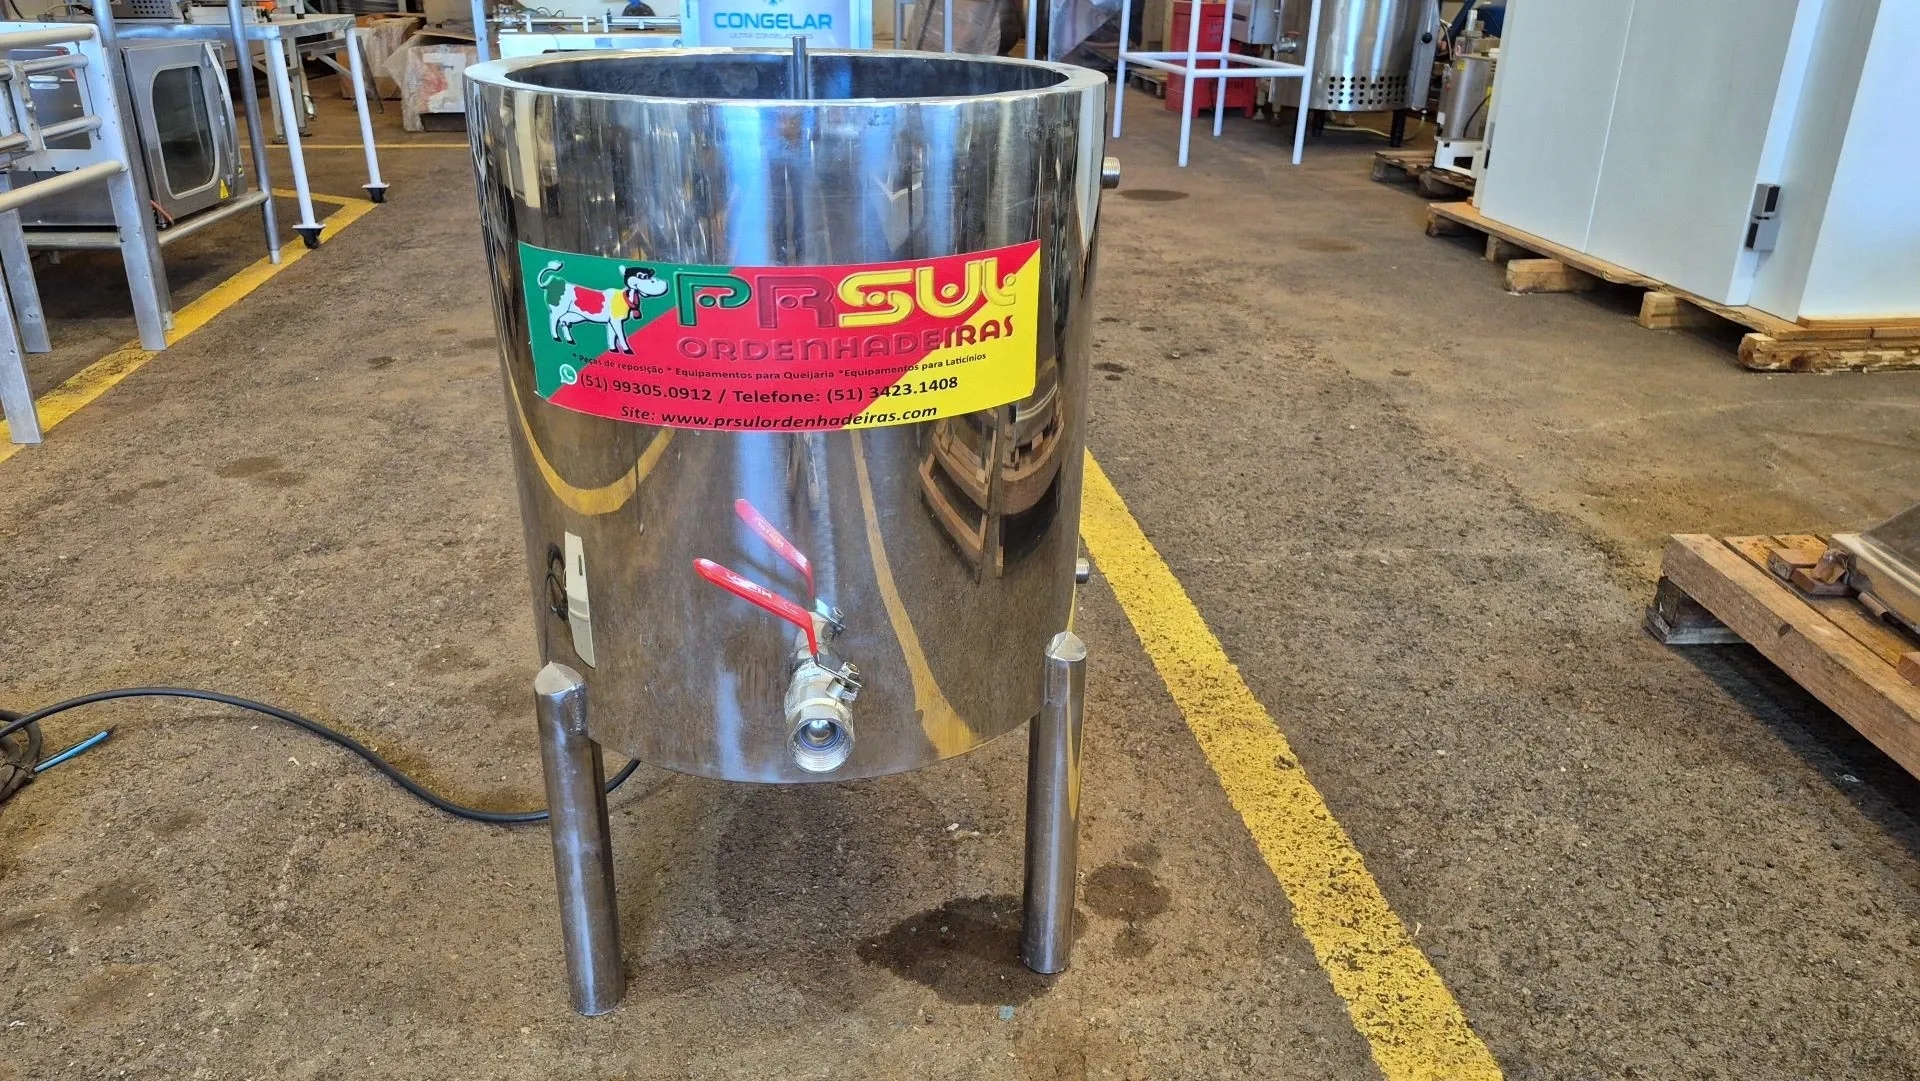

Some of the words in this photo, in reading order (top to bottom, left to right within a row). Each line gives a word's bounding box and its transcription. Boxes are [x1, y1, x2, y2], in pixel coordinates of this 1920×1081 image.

[714, 12, 832, 29] CONGELAR
[673, 257, 1016, 329] PRSUL
[677, 314, 1014, 362] ORDENHADEIRAS
[579, 355, 602, 367] Peças
[604, 359, 615, 368] de
[617, 362, 664, 375] reposição
[675, 368, 753, 380] Equipamentos
[755, 372, 780, 380] para
[784, 371, 834, 380] Queijaria
[921, 360, 943, 371] para
[945, 352, 987, 366] Laticínios
[580, 373, 608, 392] (51)
[612, 379, 713, 402] 99305.0912
[717, 388, 726, 404] /
[732, 391, 820, 403] Telefone:
[826, 387, 864, 405] (51)
[869, 376, 959, 399] 3423.1408
[620, 405, 656, 421] Site:
[661, 407, 937, 428] www.prsulordenhadeiras.com
